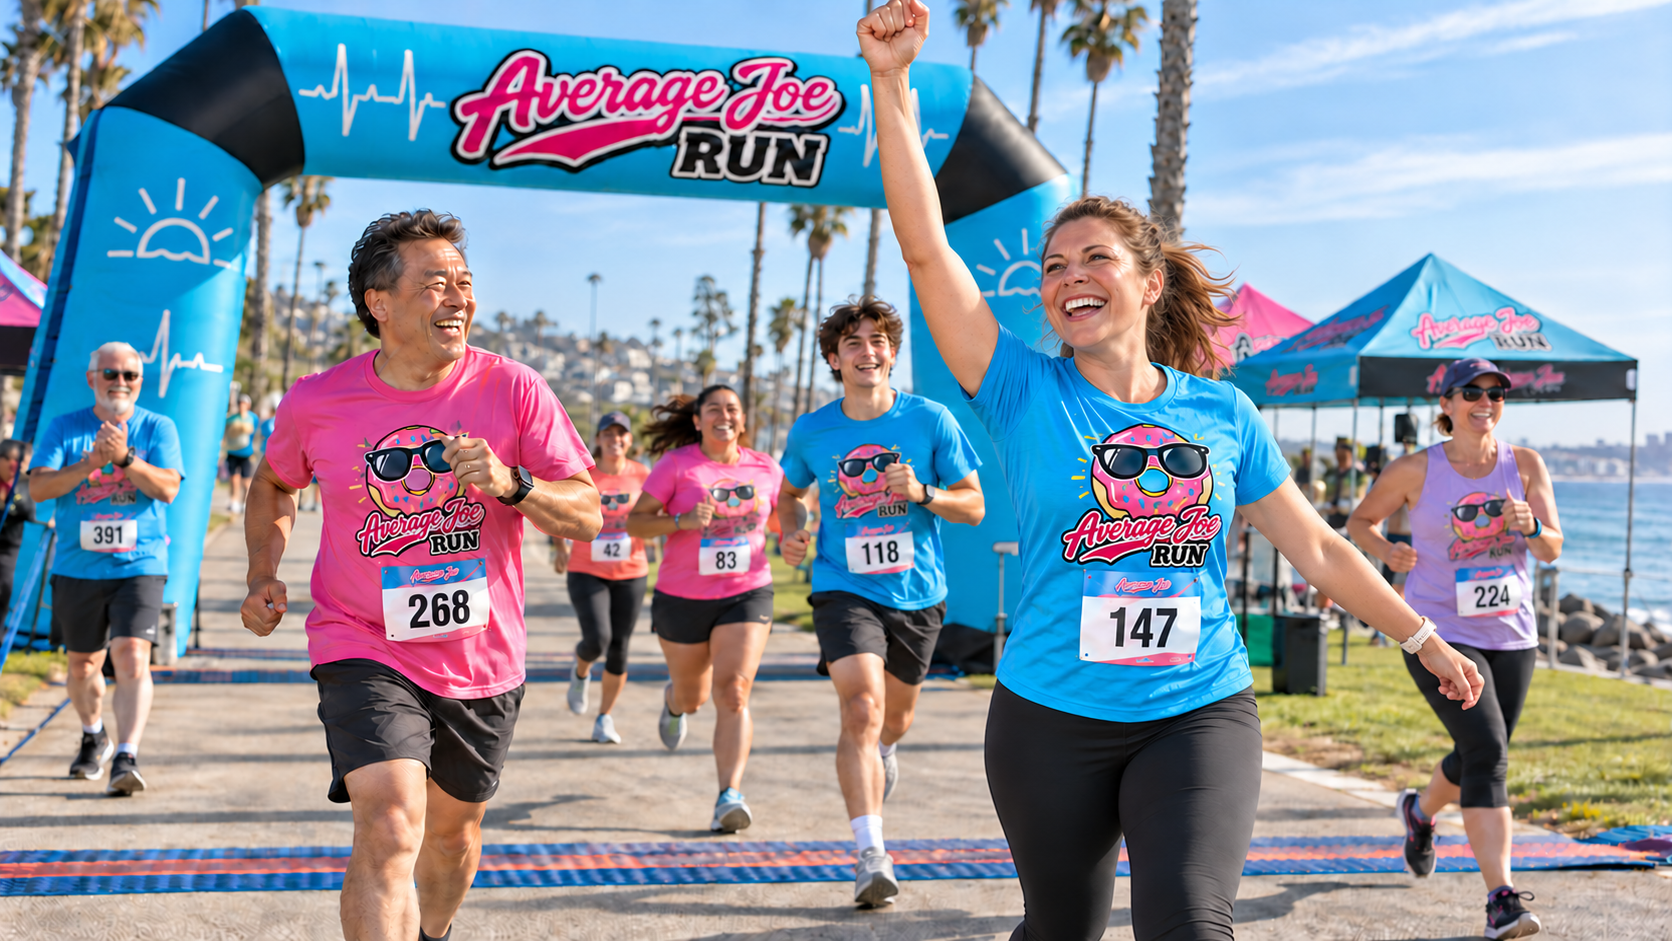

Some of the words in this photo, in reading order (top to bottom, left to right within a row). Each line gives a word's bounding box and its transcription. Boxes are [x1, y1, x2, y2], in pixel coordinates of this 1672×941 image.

[454, 49, 730, 160] Average
[720, 57, 842, 132] Joe
[670, 127, 831, 187] RUN
[1411, 312, 1498, 350] Average
[1495, 307, 1541, 334] Joe
[1492, 333, 1552, 351] RUN
[877, 502, 909, 517] RUN
[93, 525, 123, 545] 391
[357, 511, 444, 555] Average
[440, 496, 485, 533] Joe
[1063, 510, 1176, 561] Average
[1170, 505, 1222, 545] Joe
[429, 531, 480, 555] RUN
[603, 542, 621, 558] 42
[861, 540, 899, 566] 118
[1150, 543, 1208, 567] RUN
[715, 551, 737, 570] 83
[1474, 584, 1510, 608] 224
[408, 589, 471, 629] 268
[1109, 606, 1178, 648] 147
